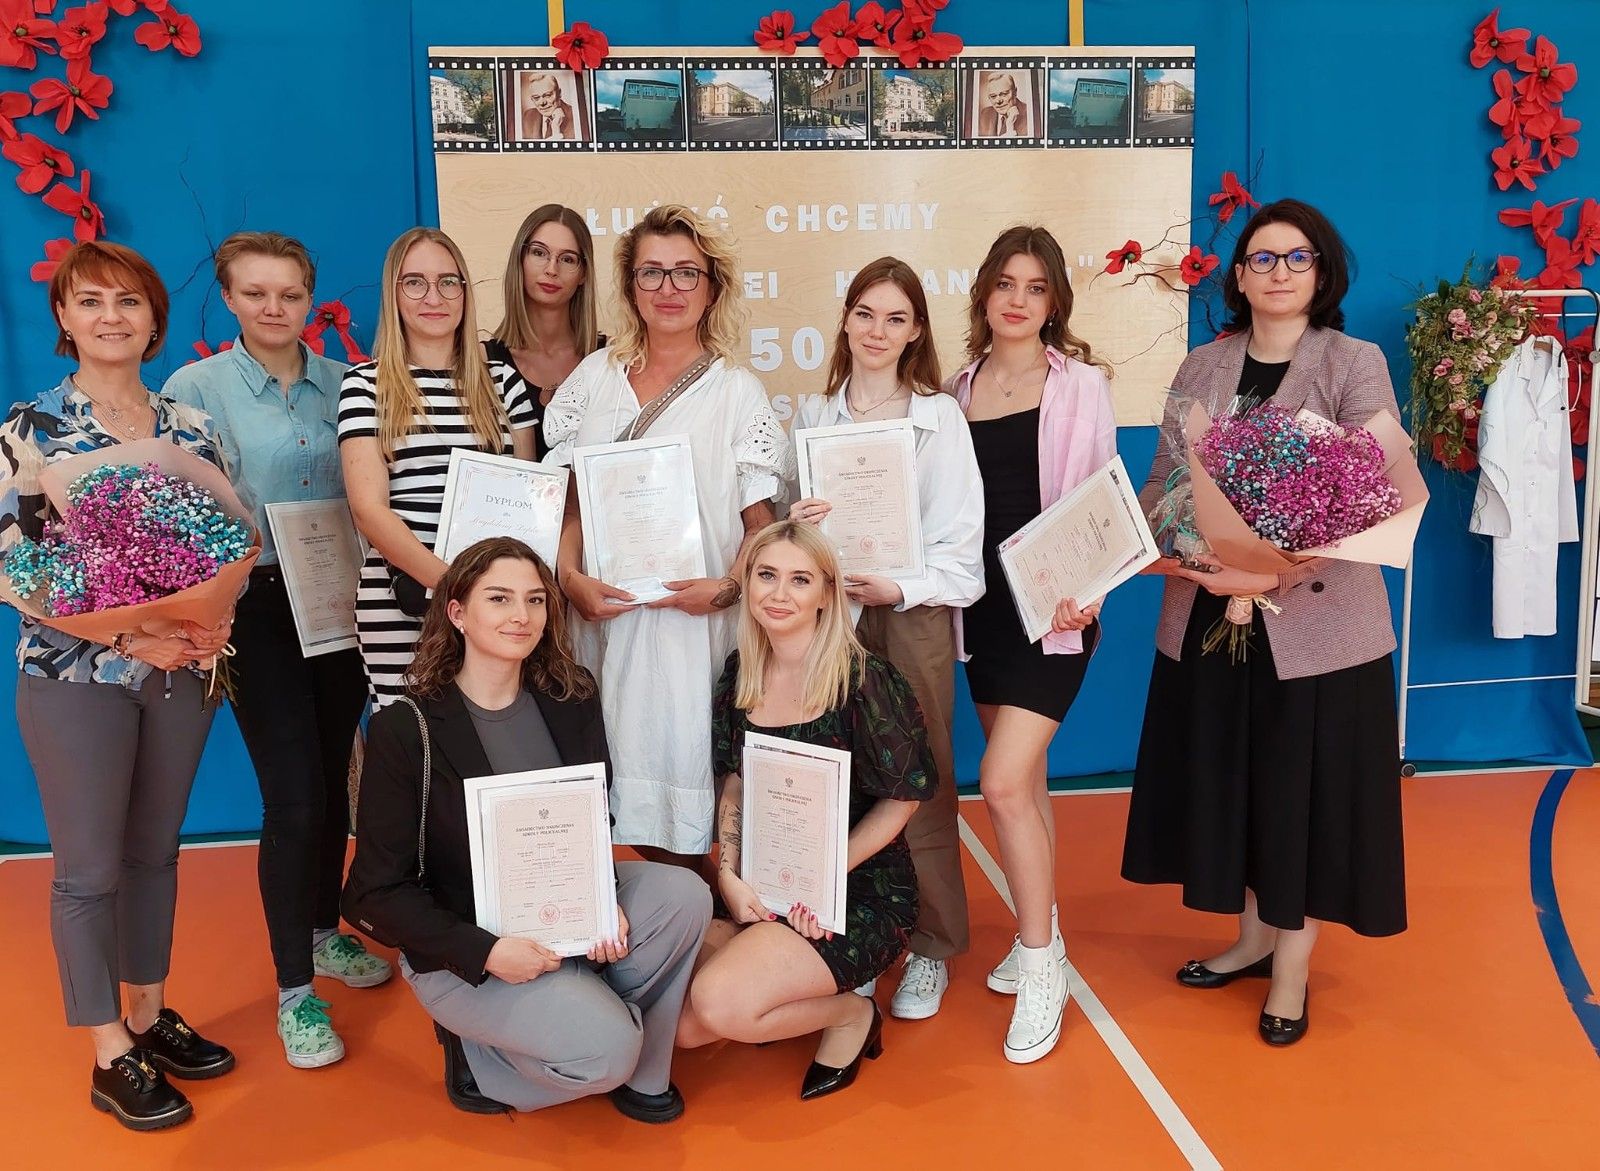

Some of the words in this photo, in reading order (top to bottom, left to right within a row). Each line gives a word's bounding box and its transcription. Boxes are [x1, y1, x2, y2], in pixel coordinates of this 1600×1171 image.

[765, 203, 940, 233] CHCEMY
[750, 327, 825, 371] 50
[485, 494, 533, 511] DYPLOM
